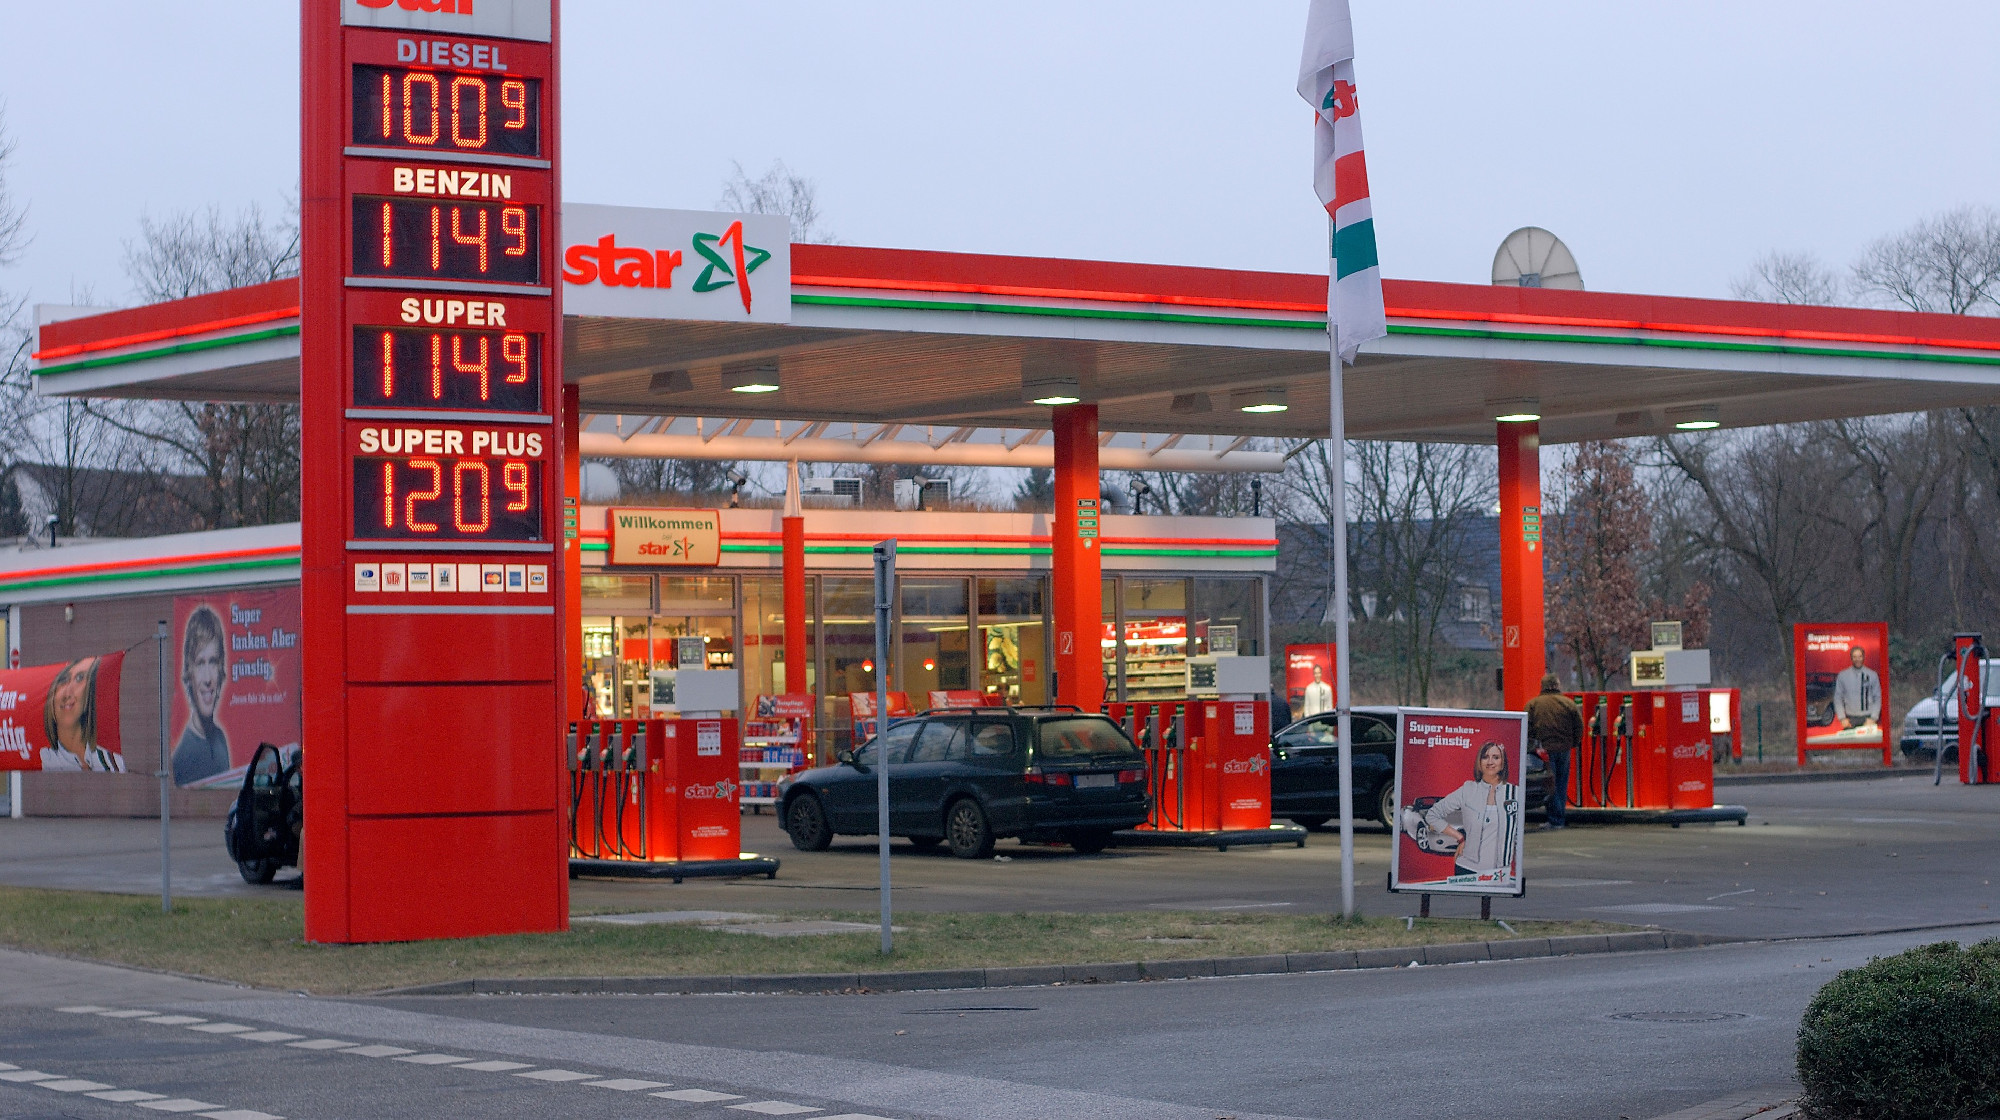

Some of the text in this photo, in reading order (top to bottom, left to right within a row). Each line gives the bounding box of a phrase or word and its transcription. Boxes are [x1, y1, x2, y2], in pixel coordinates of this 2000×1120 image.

[397, 39, 507, 70] DIESEL
[393, 167, 512, 199] BENZIN
[562, 233, 683, 289] star
[401, 298, 506, 327] SUPER
[359, 428, 543, 457] SUPER PLUS
[619, 515, 713, 530] Willkommen
[638, 541, 670, 555] star
[231, 604, 261, 627] Super
[232, 628, 296, 650] tanken. Aber
[1409, 721, 1443, 734] Super
[1409, 736, 1472, 749] aber günstig.
[1224, 759, 1249, 774] star
[684, 783, 715, 799] star
[1506, 801, 1518, 814] 98
